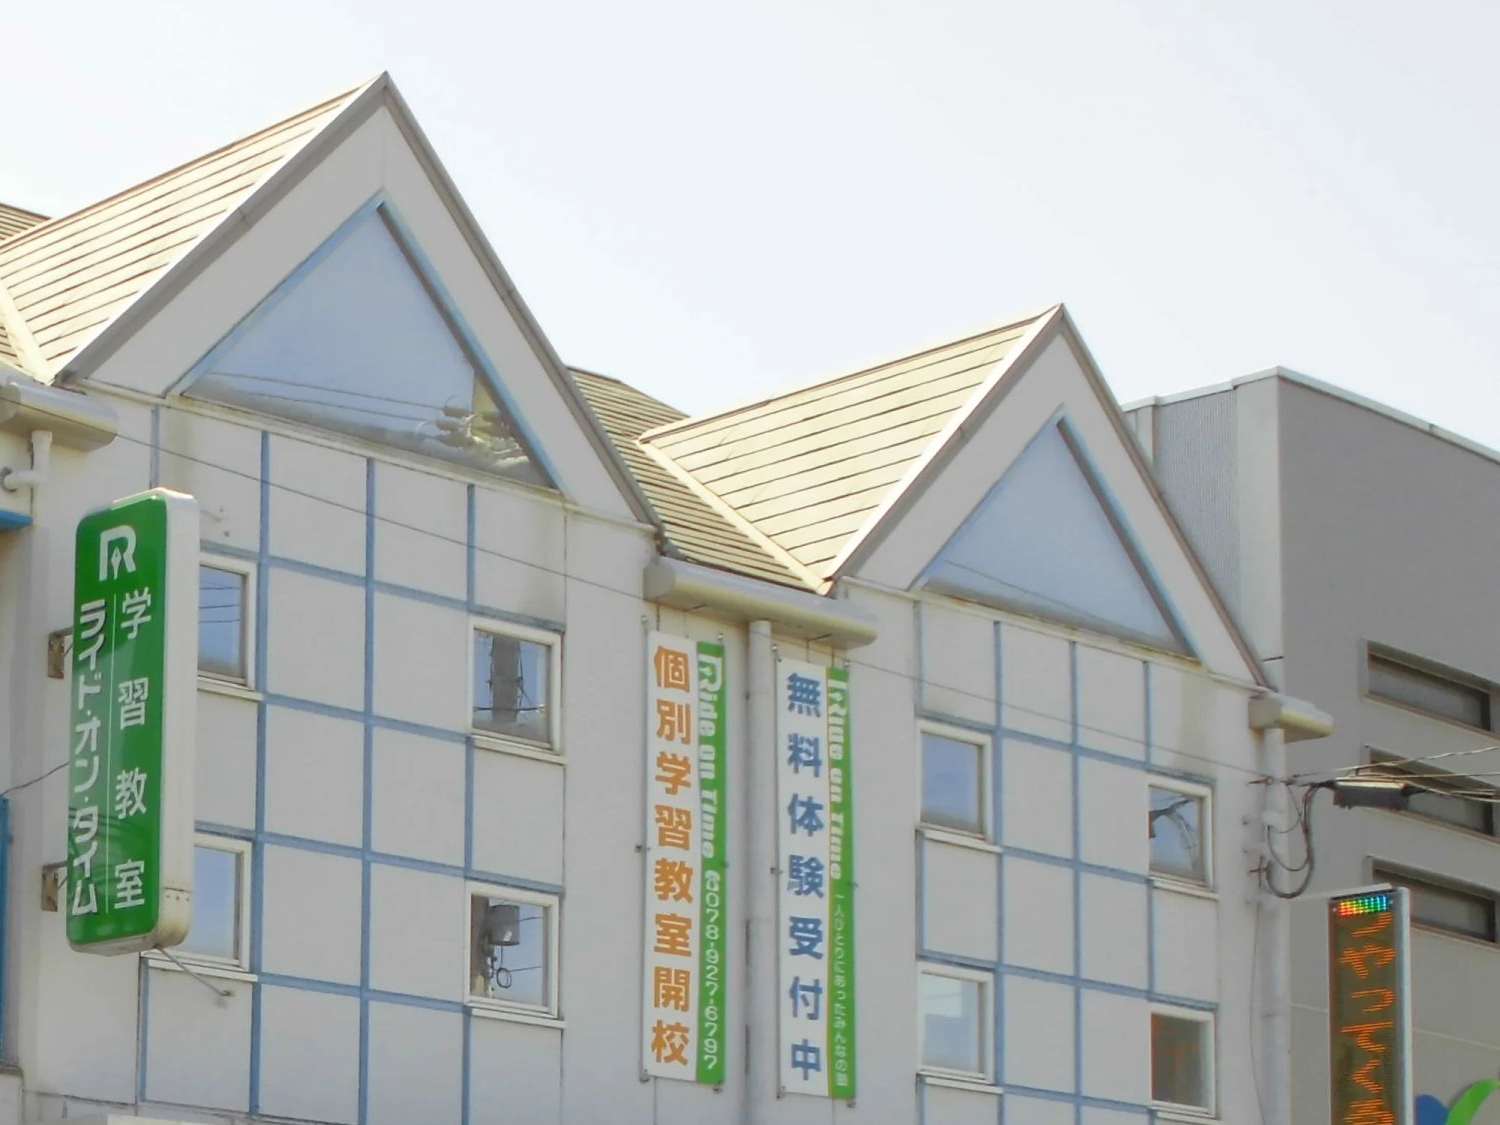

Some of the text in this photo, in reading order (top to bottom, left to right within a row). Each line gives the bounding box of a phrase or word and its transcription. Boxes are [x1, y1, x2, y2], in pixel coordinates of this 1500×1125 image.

[113, 586, 152, 911] 学習教室
[651, 645, 695, 1067] 個別学習教室開校
[787, 672, 825, 1082] 無料体験受付中
